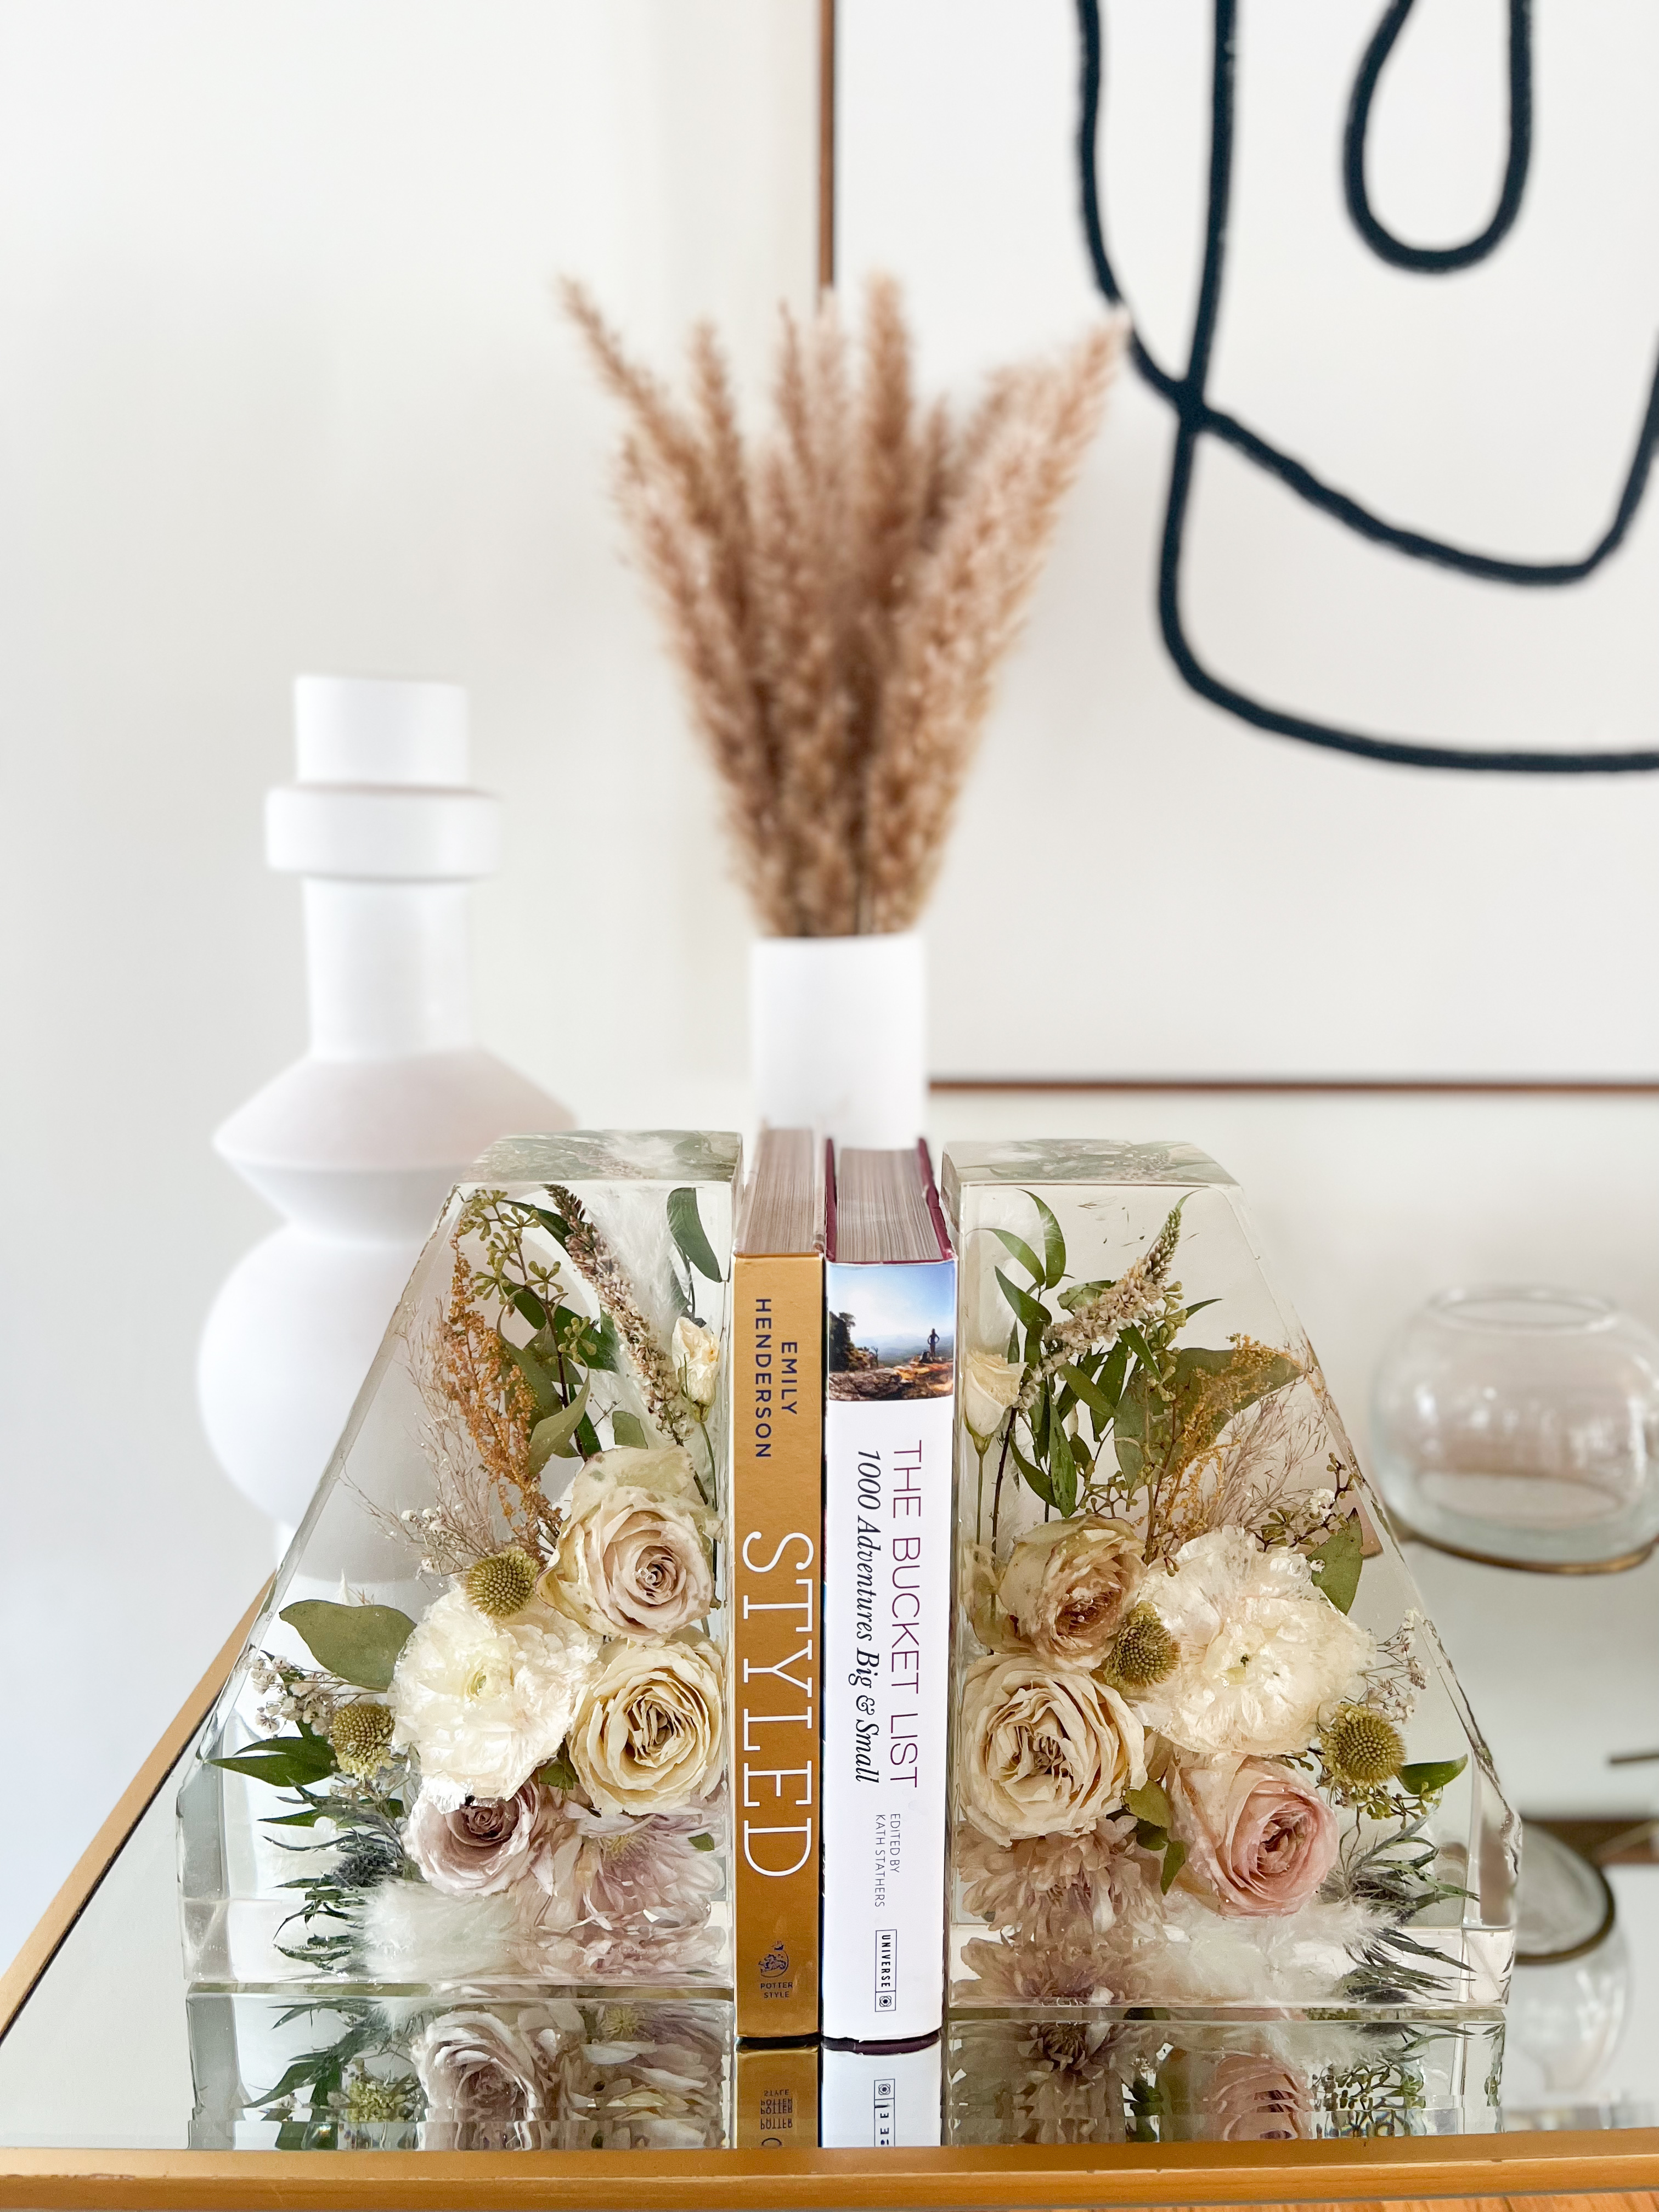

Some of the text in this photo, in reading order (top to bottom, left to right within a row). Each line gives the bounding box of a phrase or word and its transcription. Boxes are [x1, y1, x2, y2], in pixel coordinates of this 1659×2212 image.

[755, 1299, 772, 1457] HENDERSON
[781, 1342, 798, 1414] EMILY
[848, 1450, 881, 1783] 1000 Adventures Big & Small
[890, 1440, 922, 1787] THE BUCKET LIST
[742, 1531, 814, 1877] STYLED
[874, 1814, 886, 1908] KATH STATHERS
[890, 1813, 901, 1874] EDITED BY
[764, 1990, 790, 1999] STYLE
[881, 1934, 891, 1988] UNIVERSE
